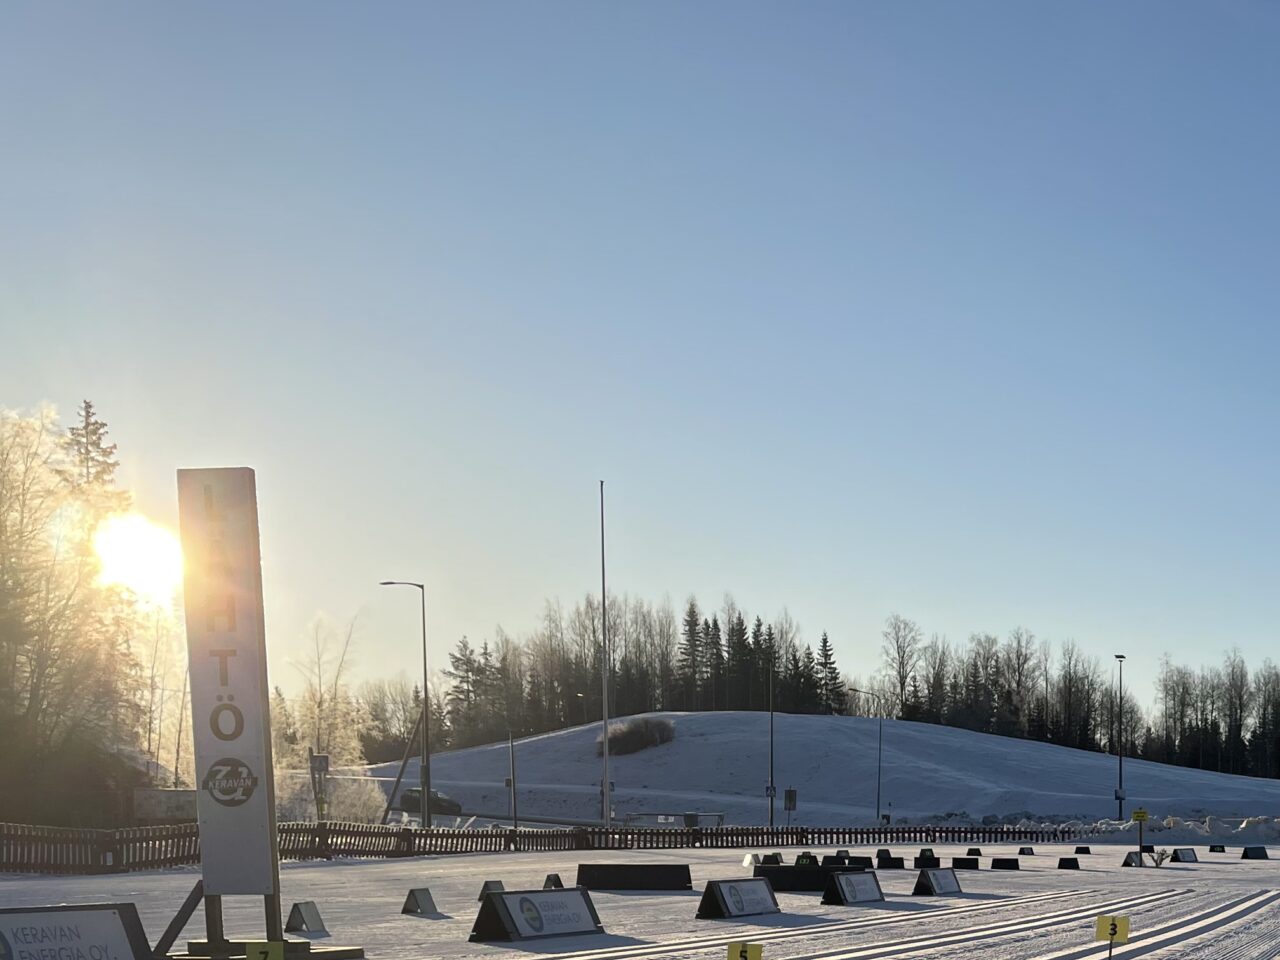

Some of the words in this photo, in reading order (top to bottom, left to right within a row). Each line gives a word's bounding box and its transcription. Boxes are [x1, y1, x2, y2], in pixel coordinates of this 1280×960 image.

[208, 776, 252, 790] KERAVAN
[10, 924, 82, 945] KERAVAN
[1108, 922, 1118, 936] 3
